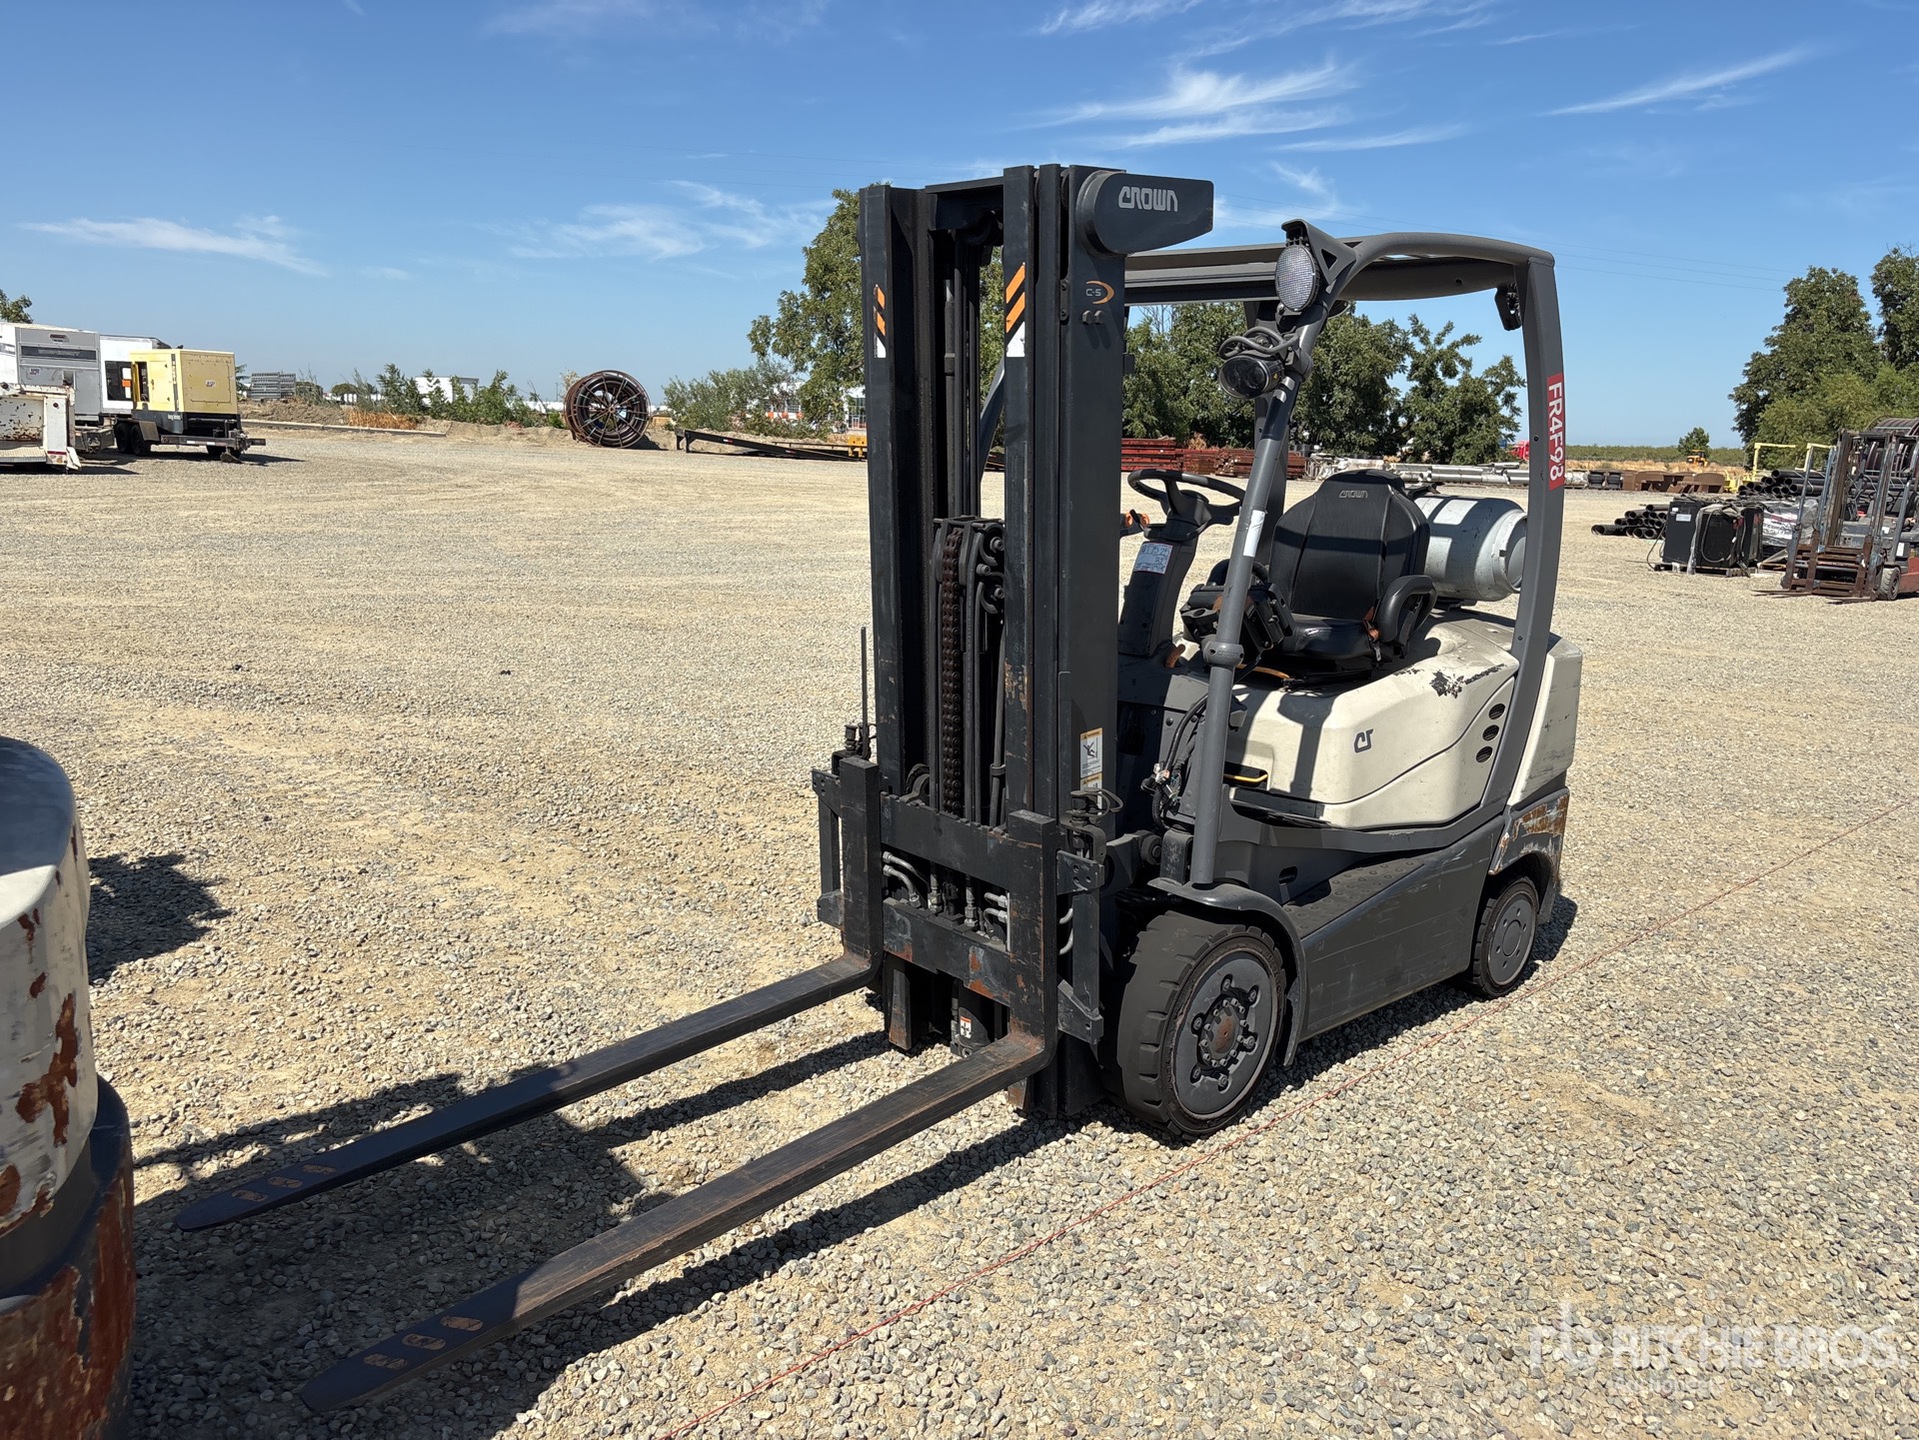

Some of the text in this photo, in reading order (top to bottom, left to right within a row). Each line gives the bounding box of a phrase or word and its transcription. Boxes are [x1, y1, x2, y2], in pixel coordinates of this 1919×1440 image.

[1118, 186, 1178, 212] CROWN
[1548, 381, 1564, 481] FR4F98
[1338, 489, 1368, 499] CROWN
